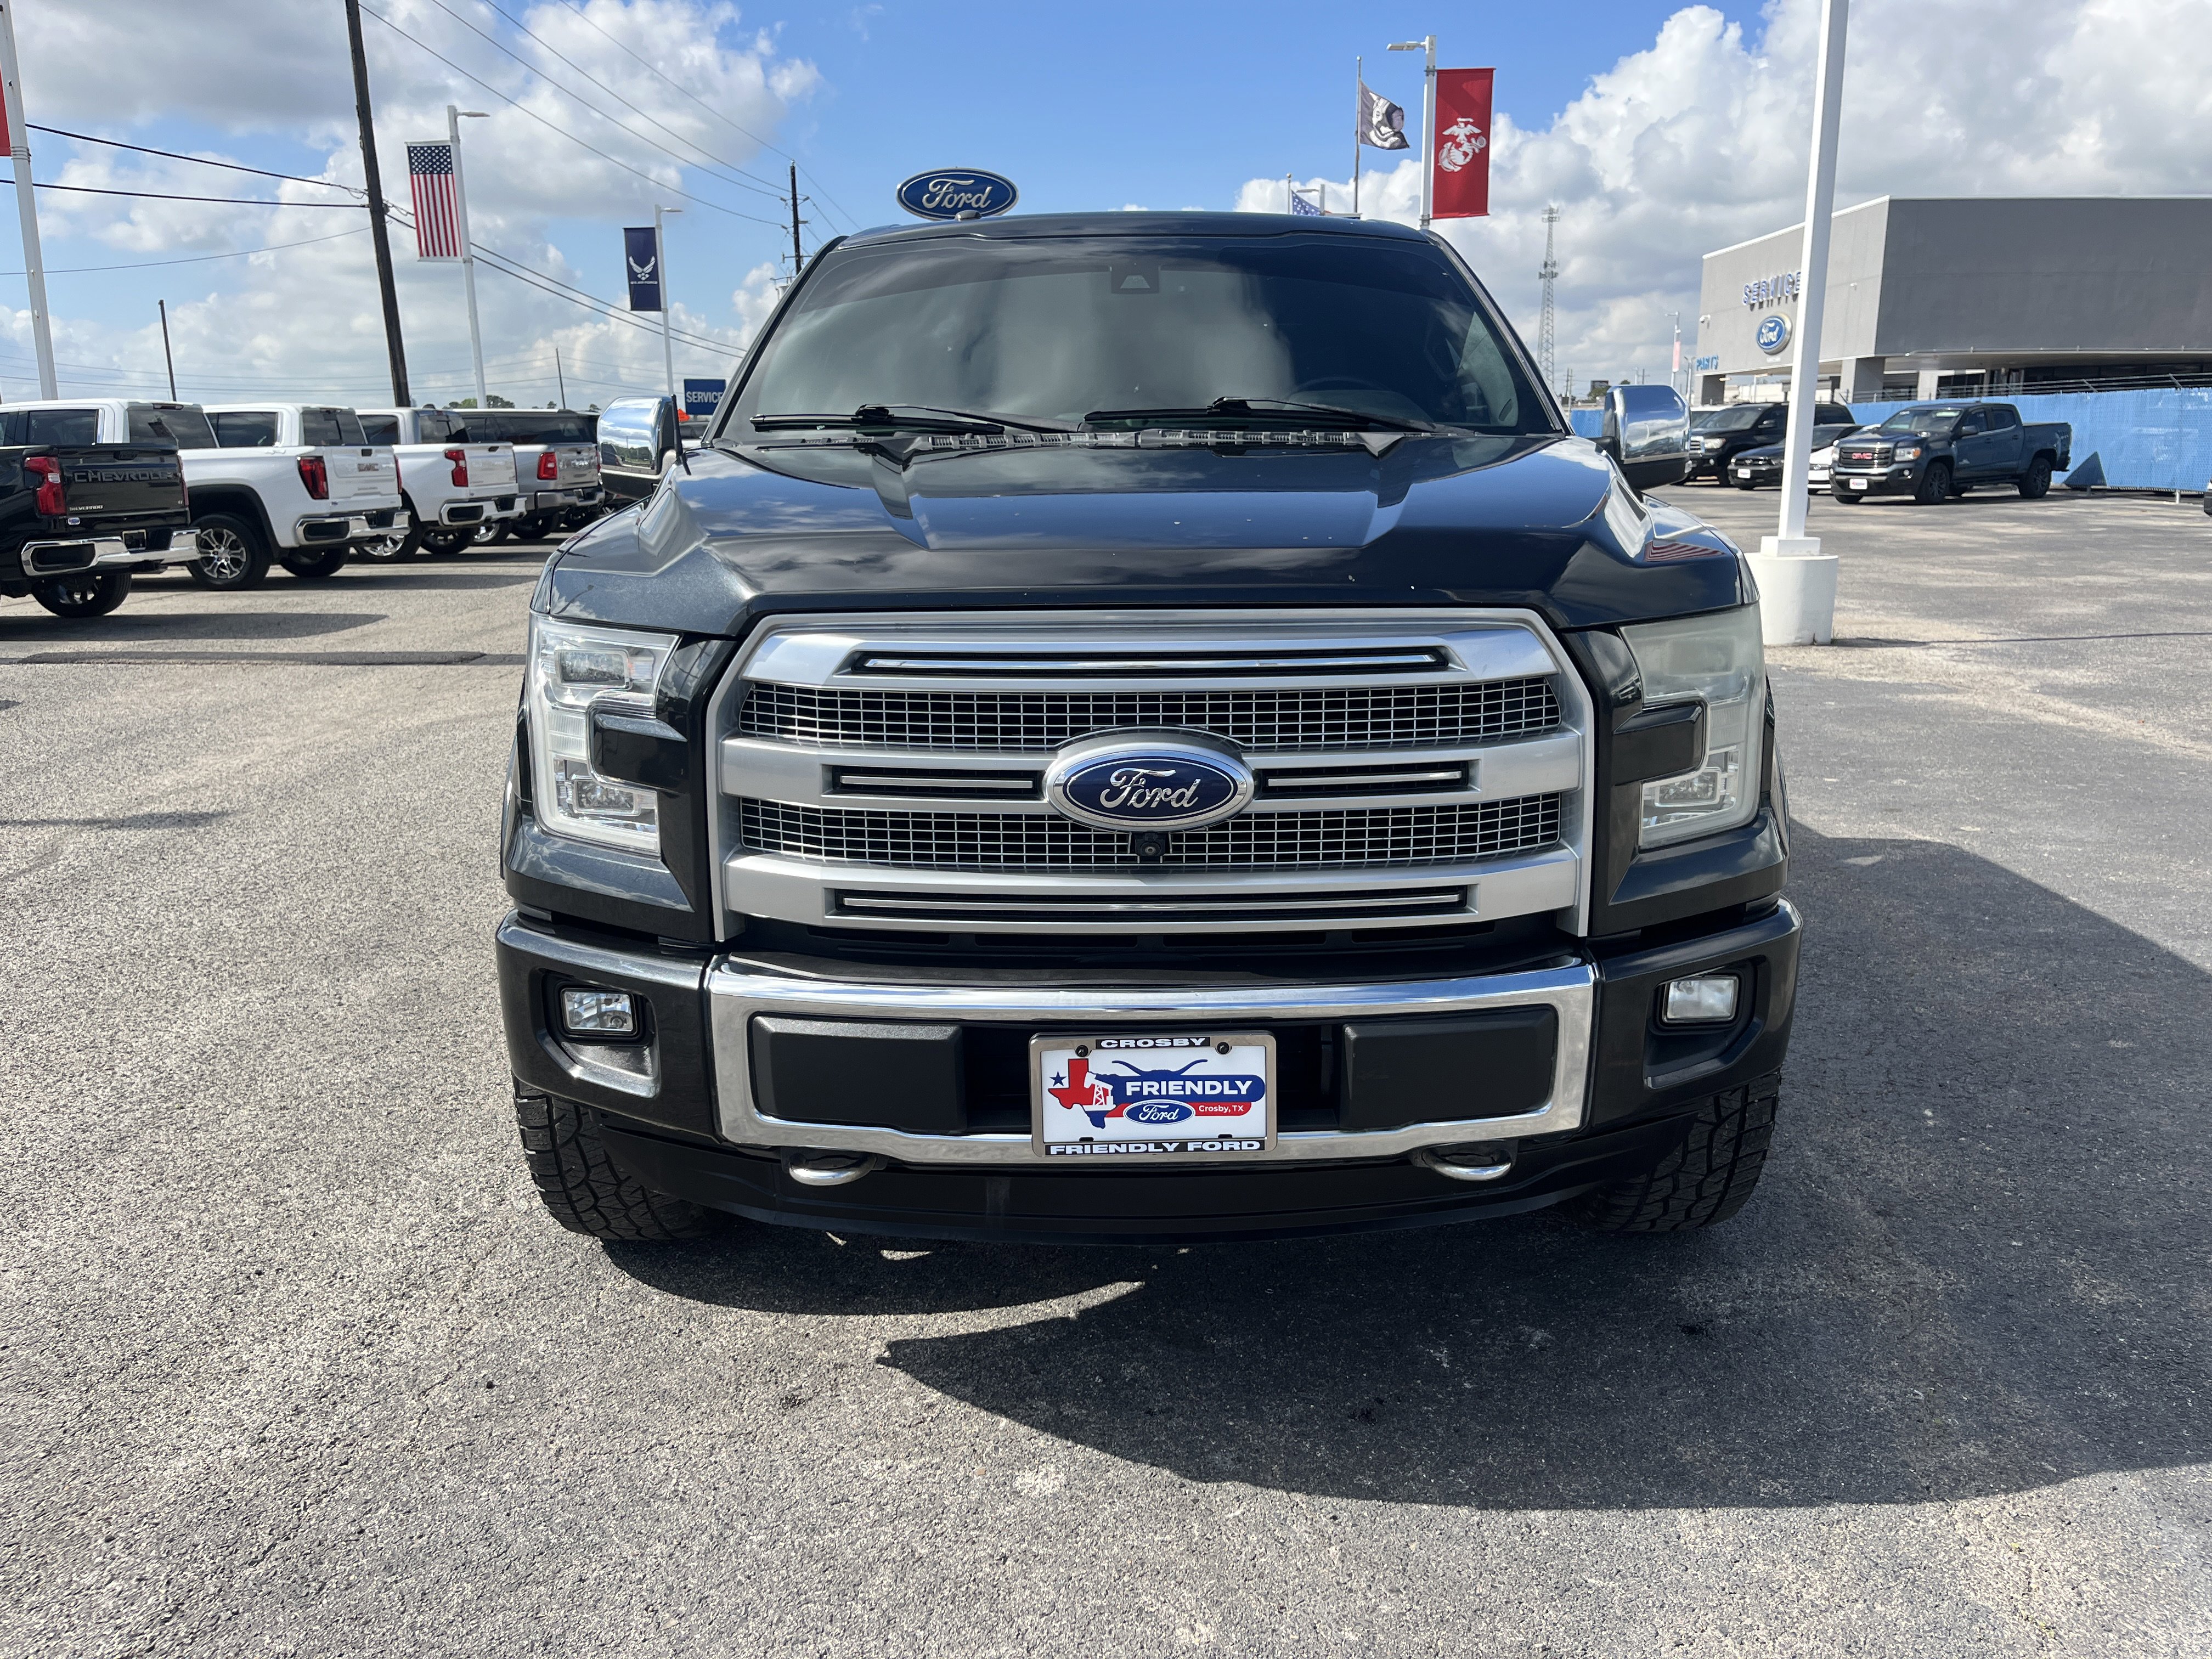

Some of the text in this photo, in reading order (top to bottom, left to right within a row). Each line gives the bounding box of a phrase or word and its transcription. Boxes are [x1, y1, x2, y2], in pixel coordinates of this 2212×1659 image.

[922, 178, 993, 209] Ford
[1742, 269, 1801, 306] SERVICE
[1759, 322, 1780, 344] Ford
[686, 391, 724, 403] SERVICE
[1099, 768, 1201, 809] Ford
[1101, 1037, 1206, 1048] CROSBY
[1126, 1080, 1253, 1096] FRIENDLY
[1138, 1104, 1179, 1121] Ford
[1198, 1104, 1231, 1113] Crosby,
[1049, 1141, 1261, 1155] FRIENDLY FORD
